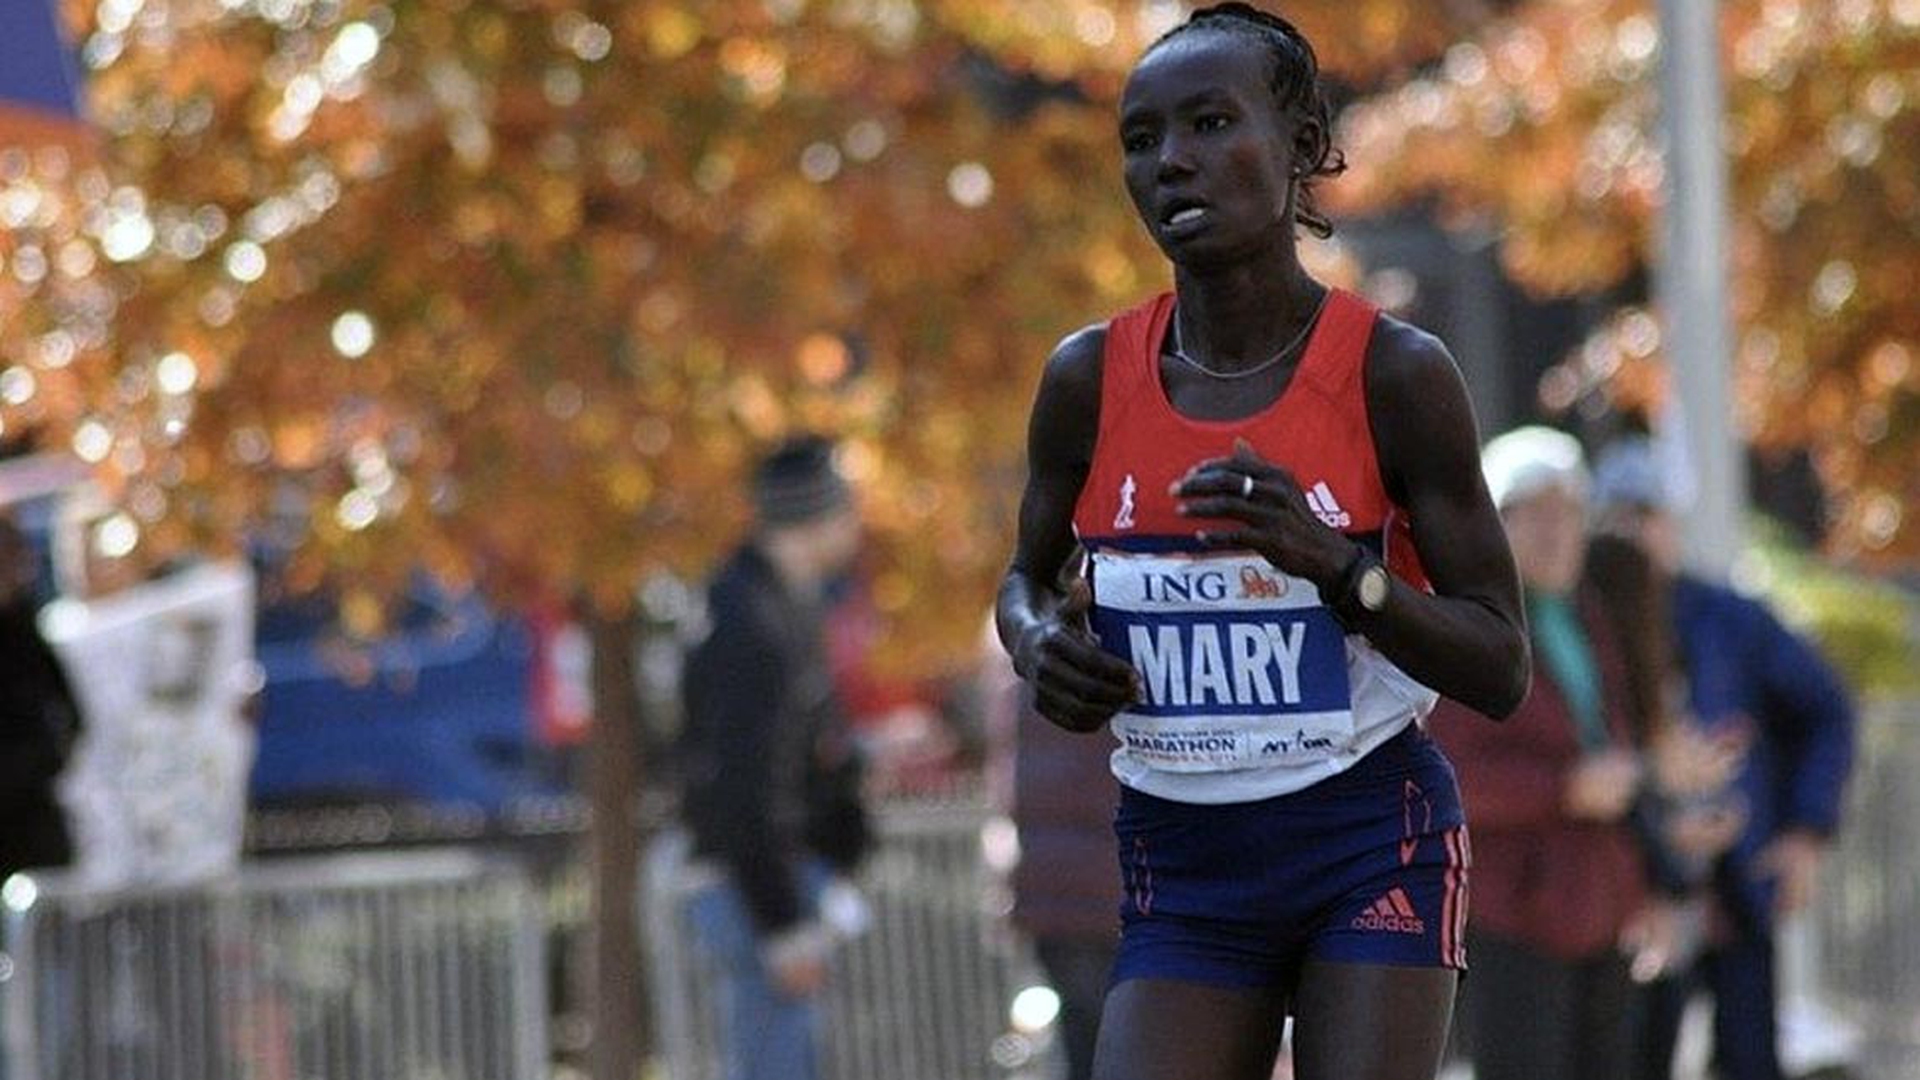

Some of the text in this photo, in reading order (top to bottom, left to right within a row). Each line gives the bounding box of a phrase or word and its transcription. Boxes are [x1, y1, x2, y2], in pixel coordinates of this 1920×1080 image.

[1142, 571, 1227, 601] ING
[1128, 621, 1306, 706] MARY
[1125, 735, 1236, 753] MARATHON
[1350, 912, 1425, 934] adidas
